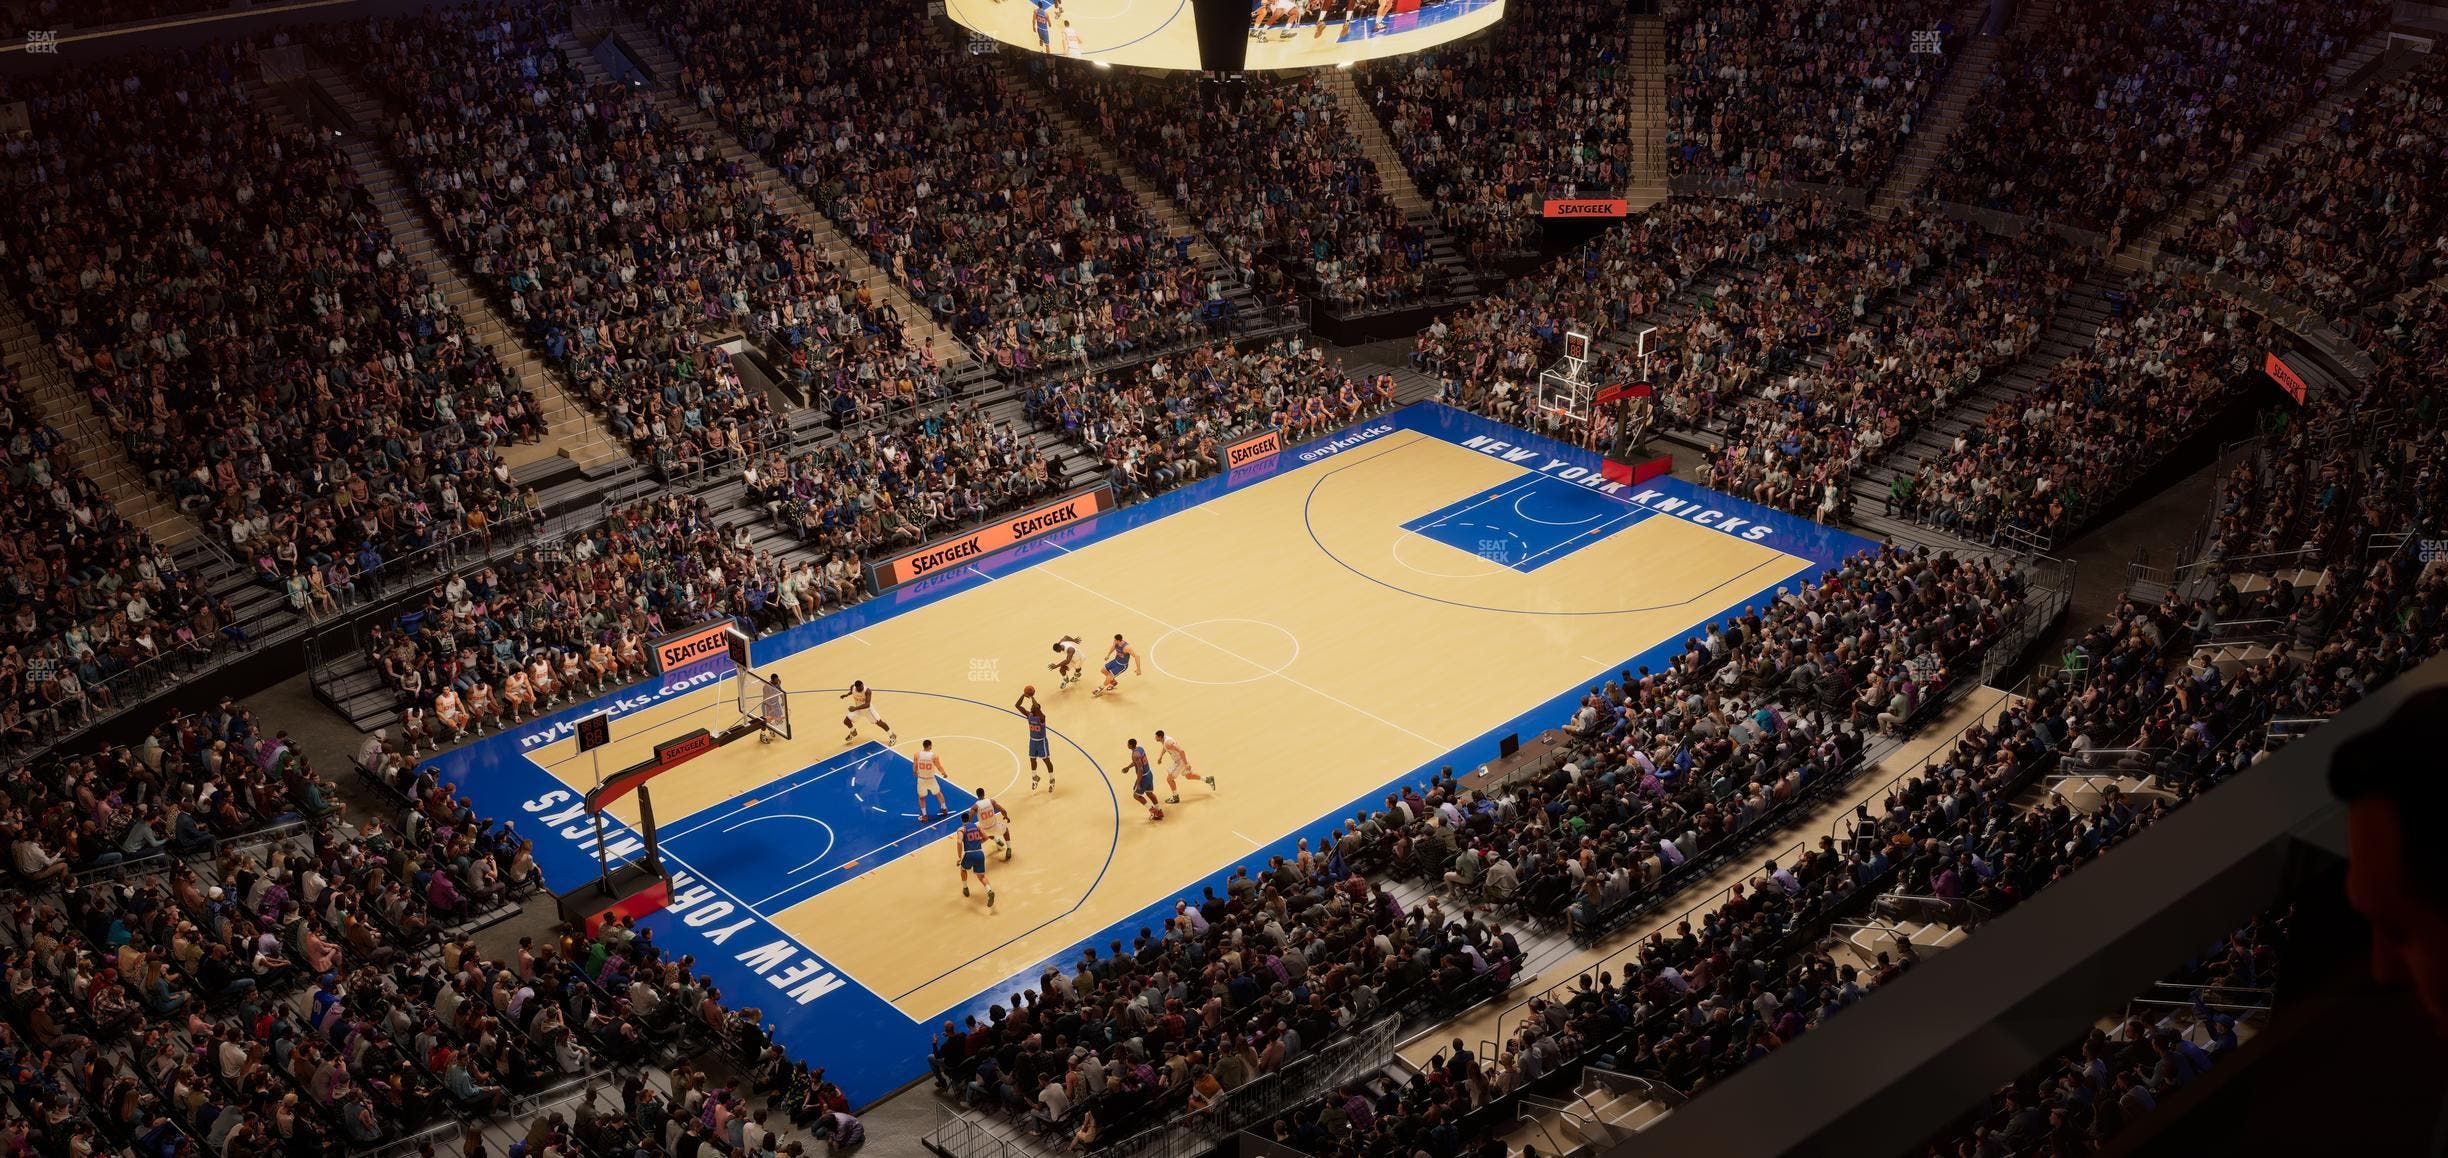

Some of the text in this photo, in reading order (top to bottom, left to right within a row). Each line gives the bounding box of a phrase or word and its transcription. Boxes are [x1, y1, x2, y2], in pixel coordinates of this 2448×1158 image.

[1558, 204, 1612, 214] SEATGEEK
[1231, 437, 1277, 464] SEATGEEK
[1299, 423, 1393, 461] @nyknicks
[1461, 435, 1773, 540] NEW YORK KNICKS
[1013, 503, 1077, 539] SEATGEEK
[912, 536, 982, 575] SEATGEEK
[520, 670, 717, 747] nykcks.com
[666, 737, 705, 759] SEATGEEK
[522, 790, 645, 871] NICKS
[734, 939, 847, 1005] NEW
